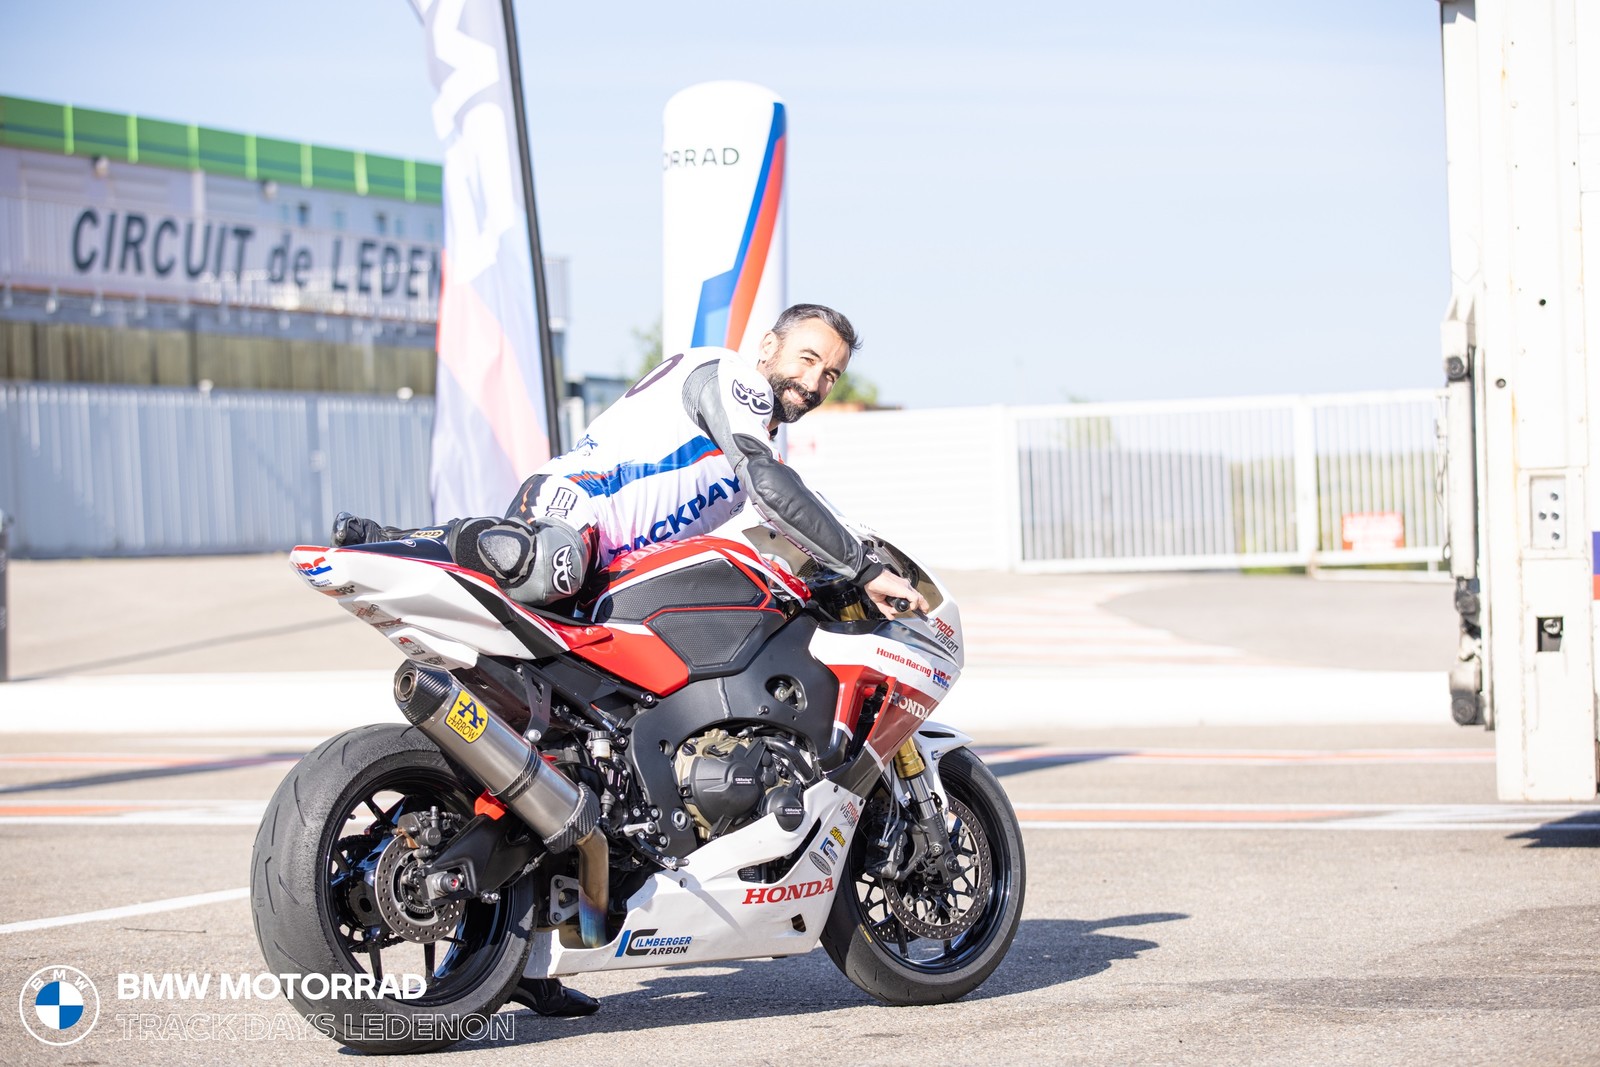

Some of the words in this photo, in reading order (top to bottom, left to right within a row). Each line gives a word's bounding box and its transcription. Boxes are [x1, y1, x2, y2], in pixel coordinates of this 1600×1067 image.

[72, 207, 254, 281] CIRCUIT
[267, 233, 313, 287] de
[935, 617, 956, 638] moto
[876, 647, 906, 664] Honda
[905, 658, 932, 678] Racing
[888, 691, 930, 720] HONDA
[448, 715, 478, 740] ARROW
[742, 876, 834, 905] HONDA
